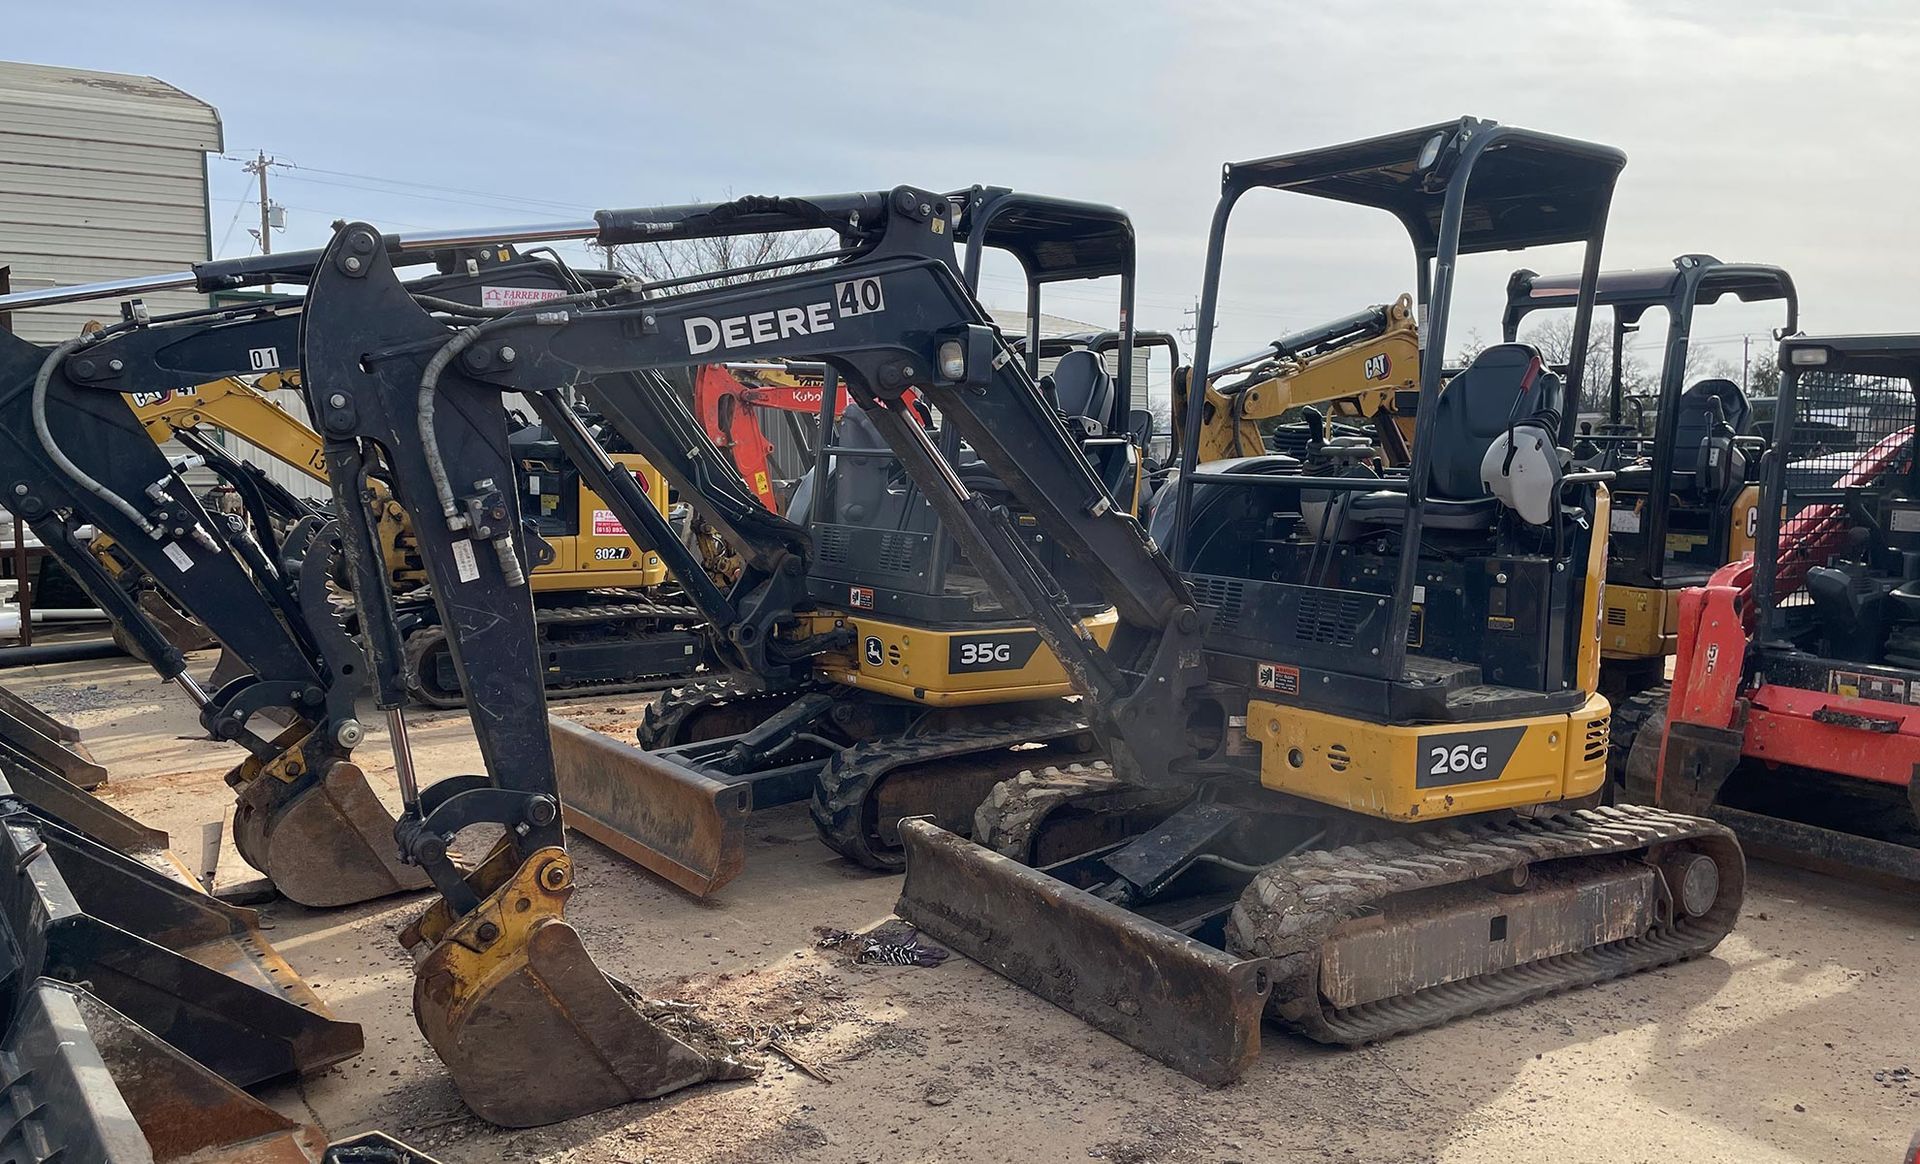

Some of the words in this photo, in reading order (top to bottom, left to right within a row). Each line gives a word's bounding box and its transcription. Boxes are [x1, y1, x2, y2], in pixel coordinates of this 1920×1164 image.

[503, 290, 539, 300] FARRER
[839, 279, 881, 314] 40
[683, 302, 835, 355] DEERE
[252, 350, 276, 369] 01
[1365, 354, 1385, 379] CAT
[308, 448, 328, 475] 13
[595, 548, 626, 560] 302.7
[961, 643, 1010, 664] 35G
[1430, 745, 1488, 775] 26G
